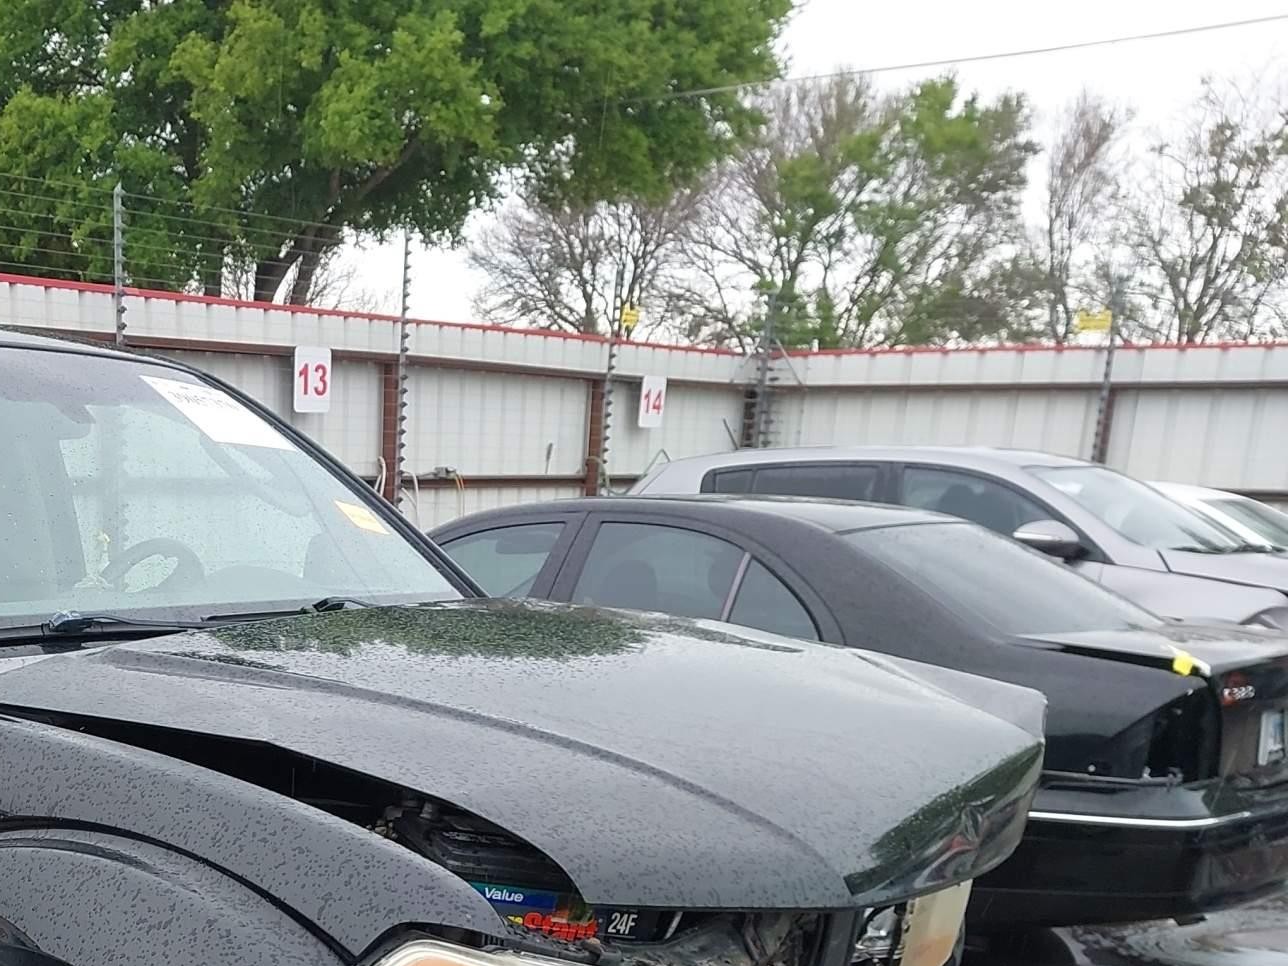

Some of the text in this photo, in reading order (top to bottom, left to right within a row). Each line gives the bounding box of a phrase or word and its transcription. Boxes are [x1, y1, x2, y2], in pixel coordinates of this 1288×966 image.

[297, 362, 328, 397] 13
[644, 389, 662, 415] 14
[484, 886, 524, 903] Value
[607, 911, 638, 935] 24F
